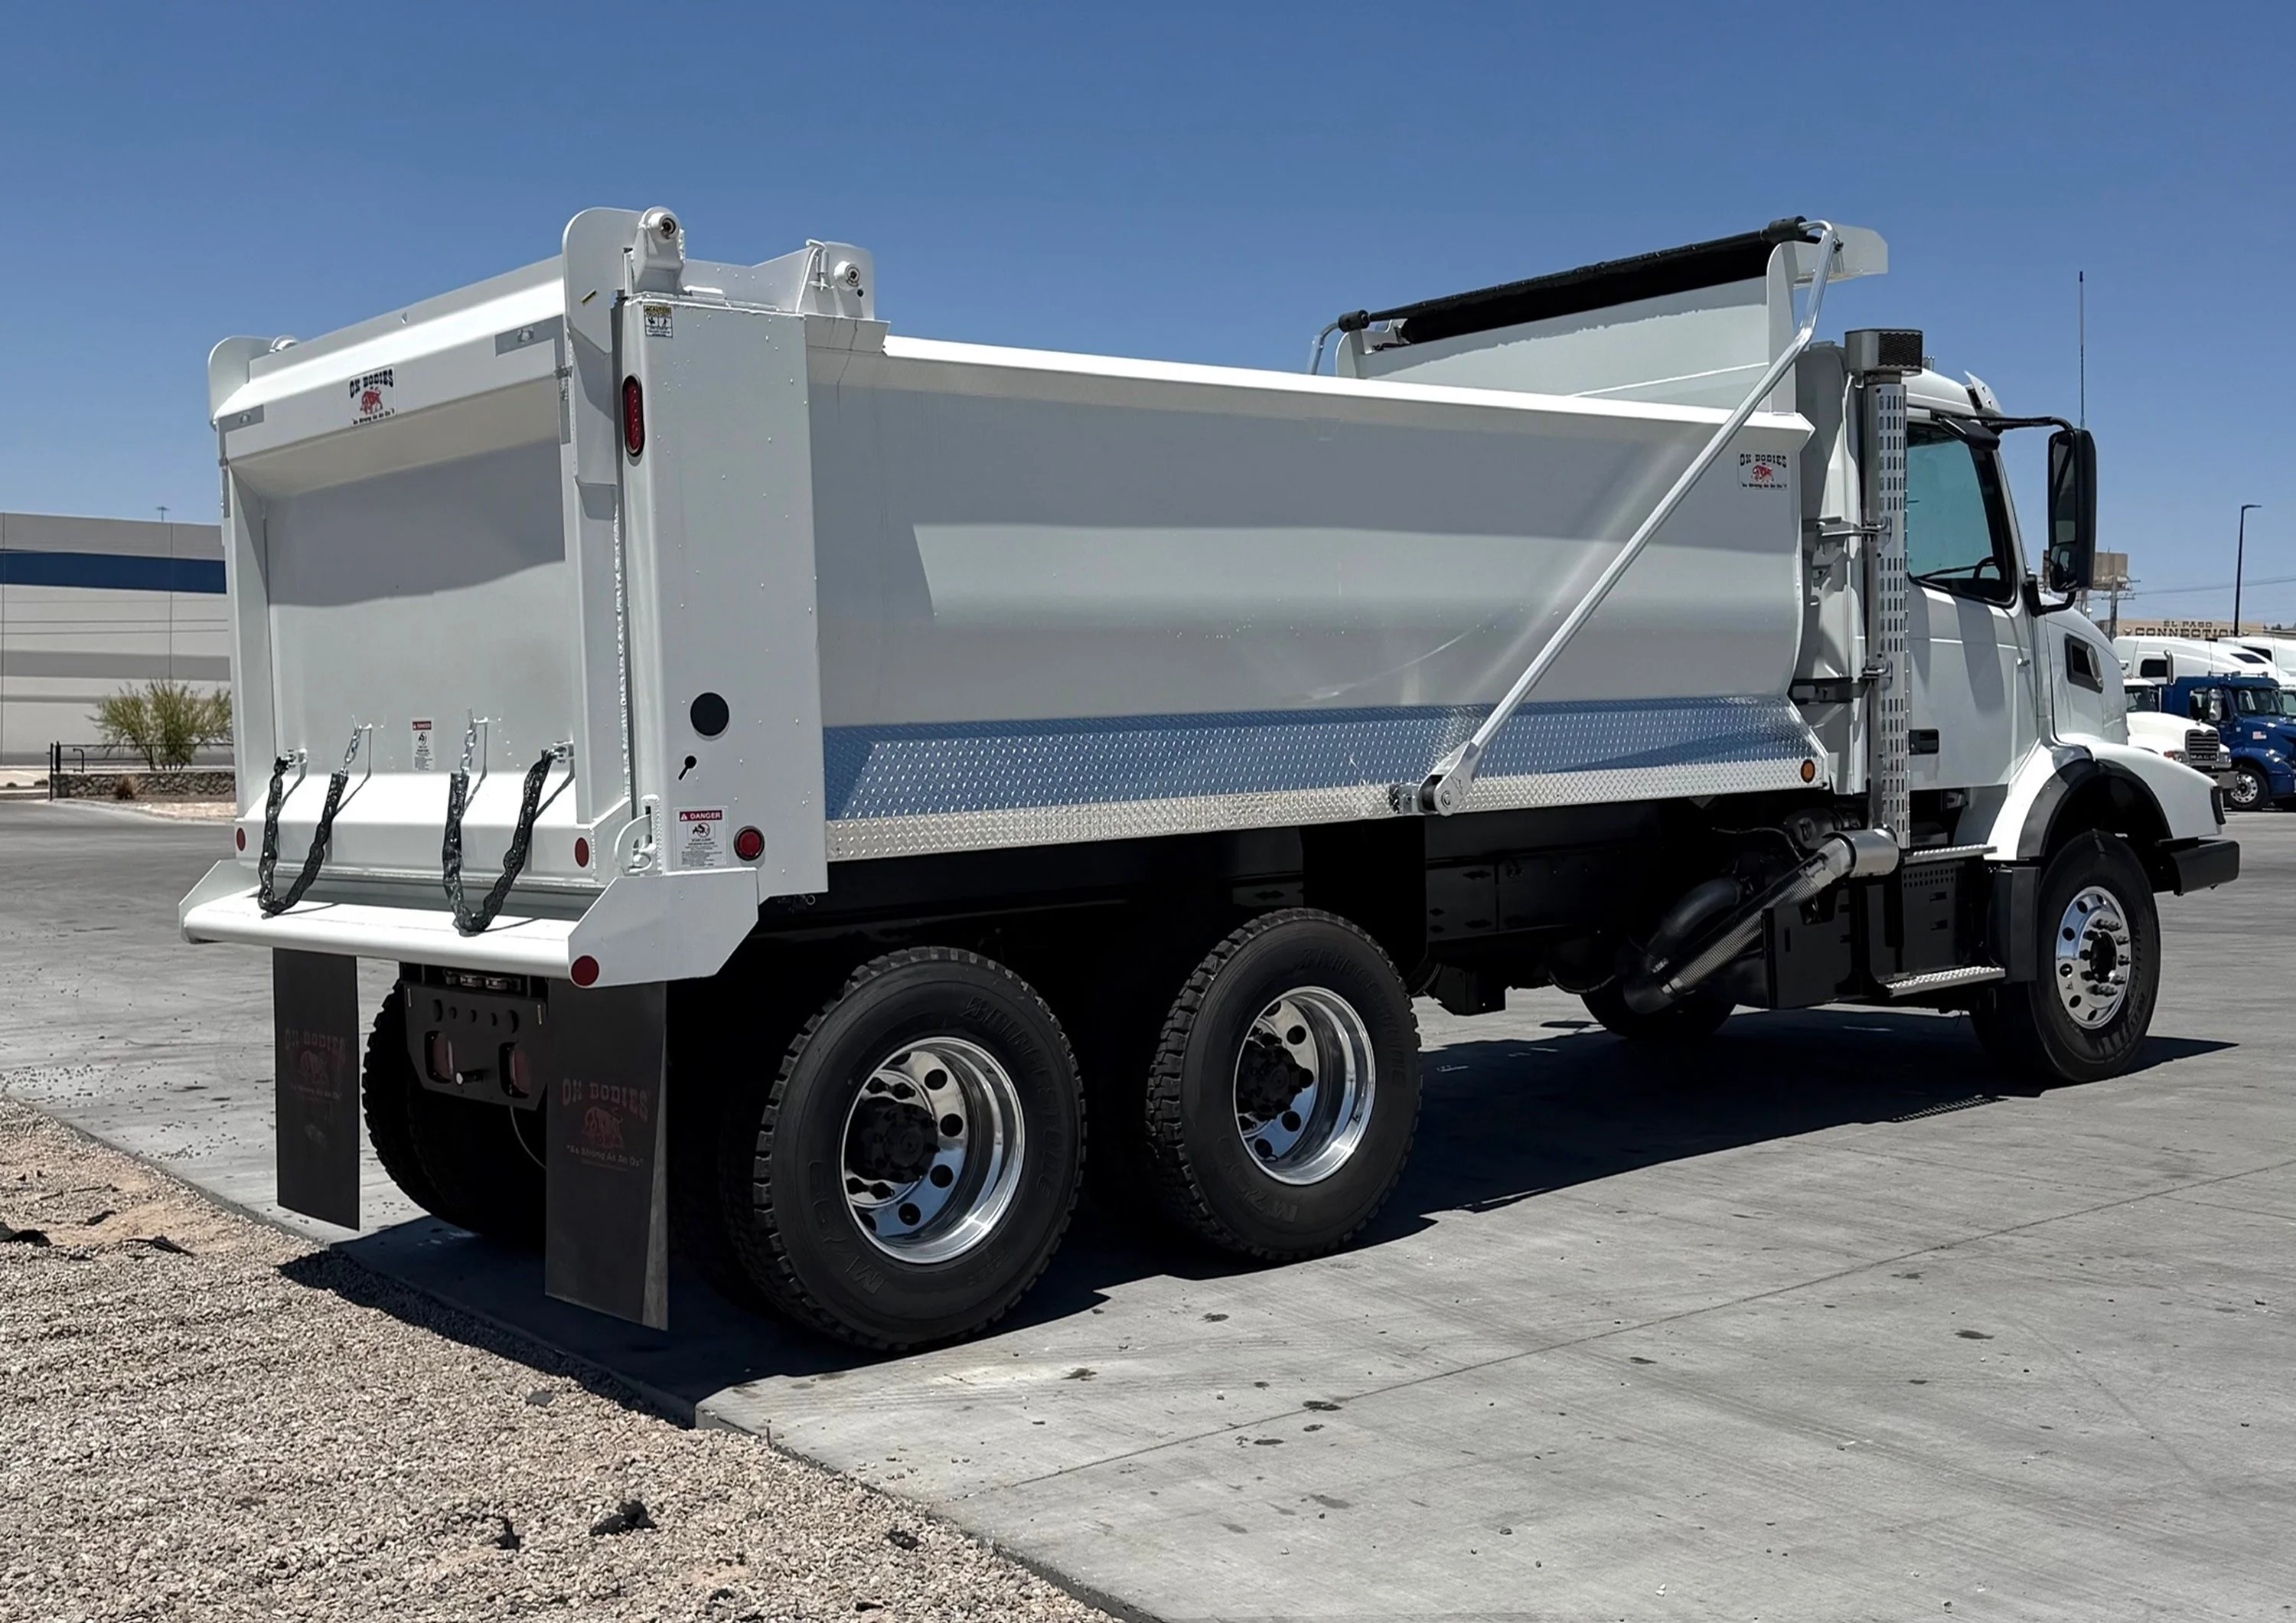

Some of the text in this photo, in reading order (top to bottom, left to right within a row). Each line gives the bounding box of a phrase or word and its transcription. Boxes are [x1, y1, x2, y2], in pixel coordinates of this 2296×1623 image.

[363, 369, 393, 388] BODIES
[1755, 454, 1787, 468] BODIES
[690, 812, 721, 820] DANGER
[589, 1082, 649, 1122] BODIES
